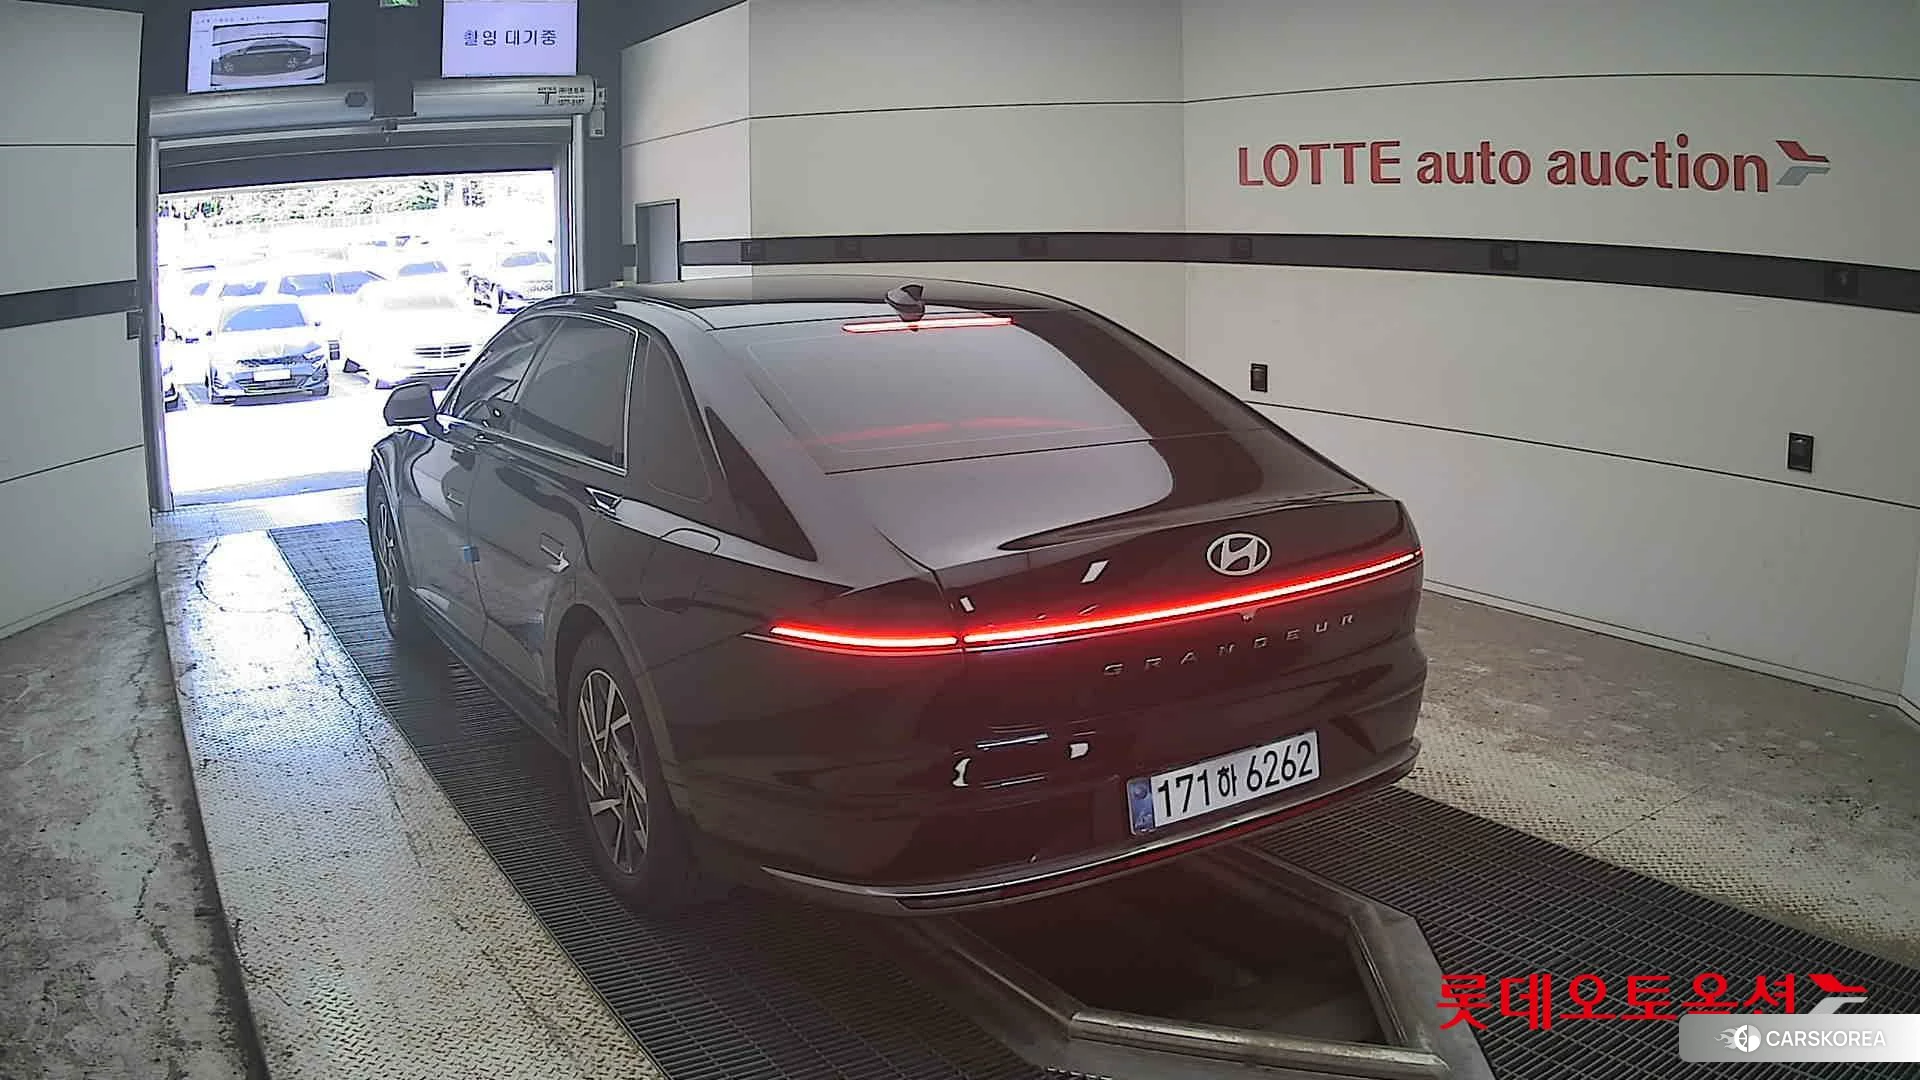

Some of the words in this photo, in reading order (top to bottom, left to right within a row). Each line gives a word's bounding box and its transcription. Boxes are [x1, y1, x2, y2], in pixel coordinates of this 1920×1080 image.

[505, 30, 557, 46] 대기중
[1238, 140, 1400, 187] LOTTE
[1417, 140, 1531, 186] auto
[1547, 133, 1769, 192] auction
[1103, 613, 1353, 676] GRANDEUR
[1246, 740, 1313, 792] 6262
